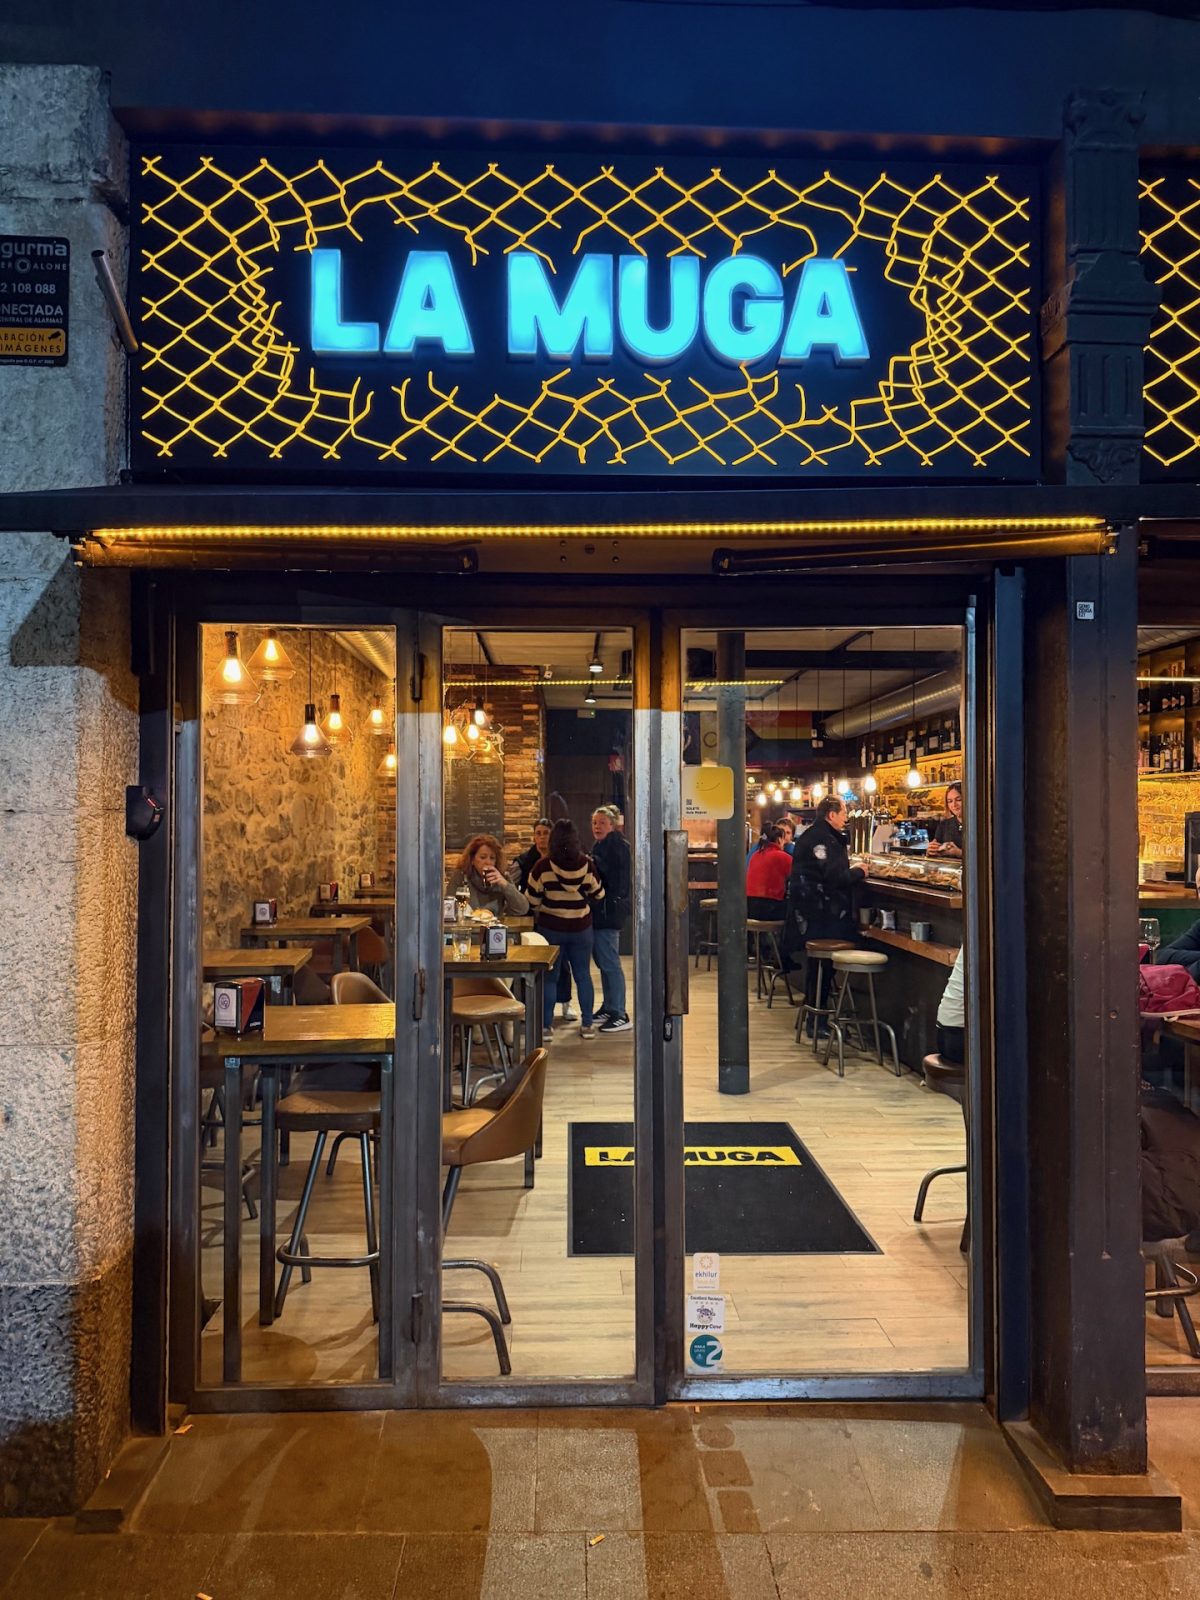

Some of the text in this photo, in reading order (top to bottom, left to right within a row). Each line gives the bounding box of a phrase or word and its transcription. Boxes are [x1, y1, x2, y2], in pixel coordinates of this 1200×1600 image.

[33, 262, 67, 271] ALONE
[13, 283, 31, 293] 108
[35, 284, 56, 294] 088
[0, 304, 64, 316] NECTADA
[311, 249, 870, 366] LA MUGA
[706, 1341, 722, 1365] 2
